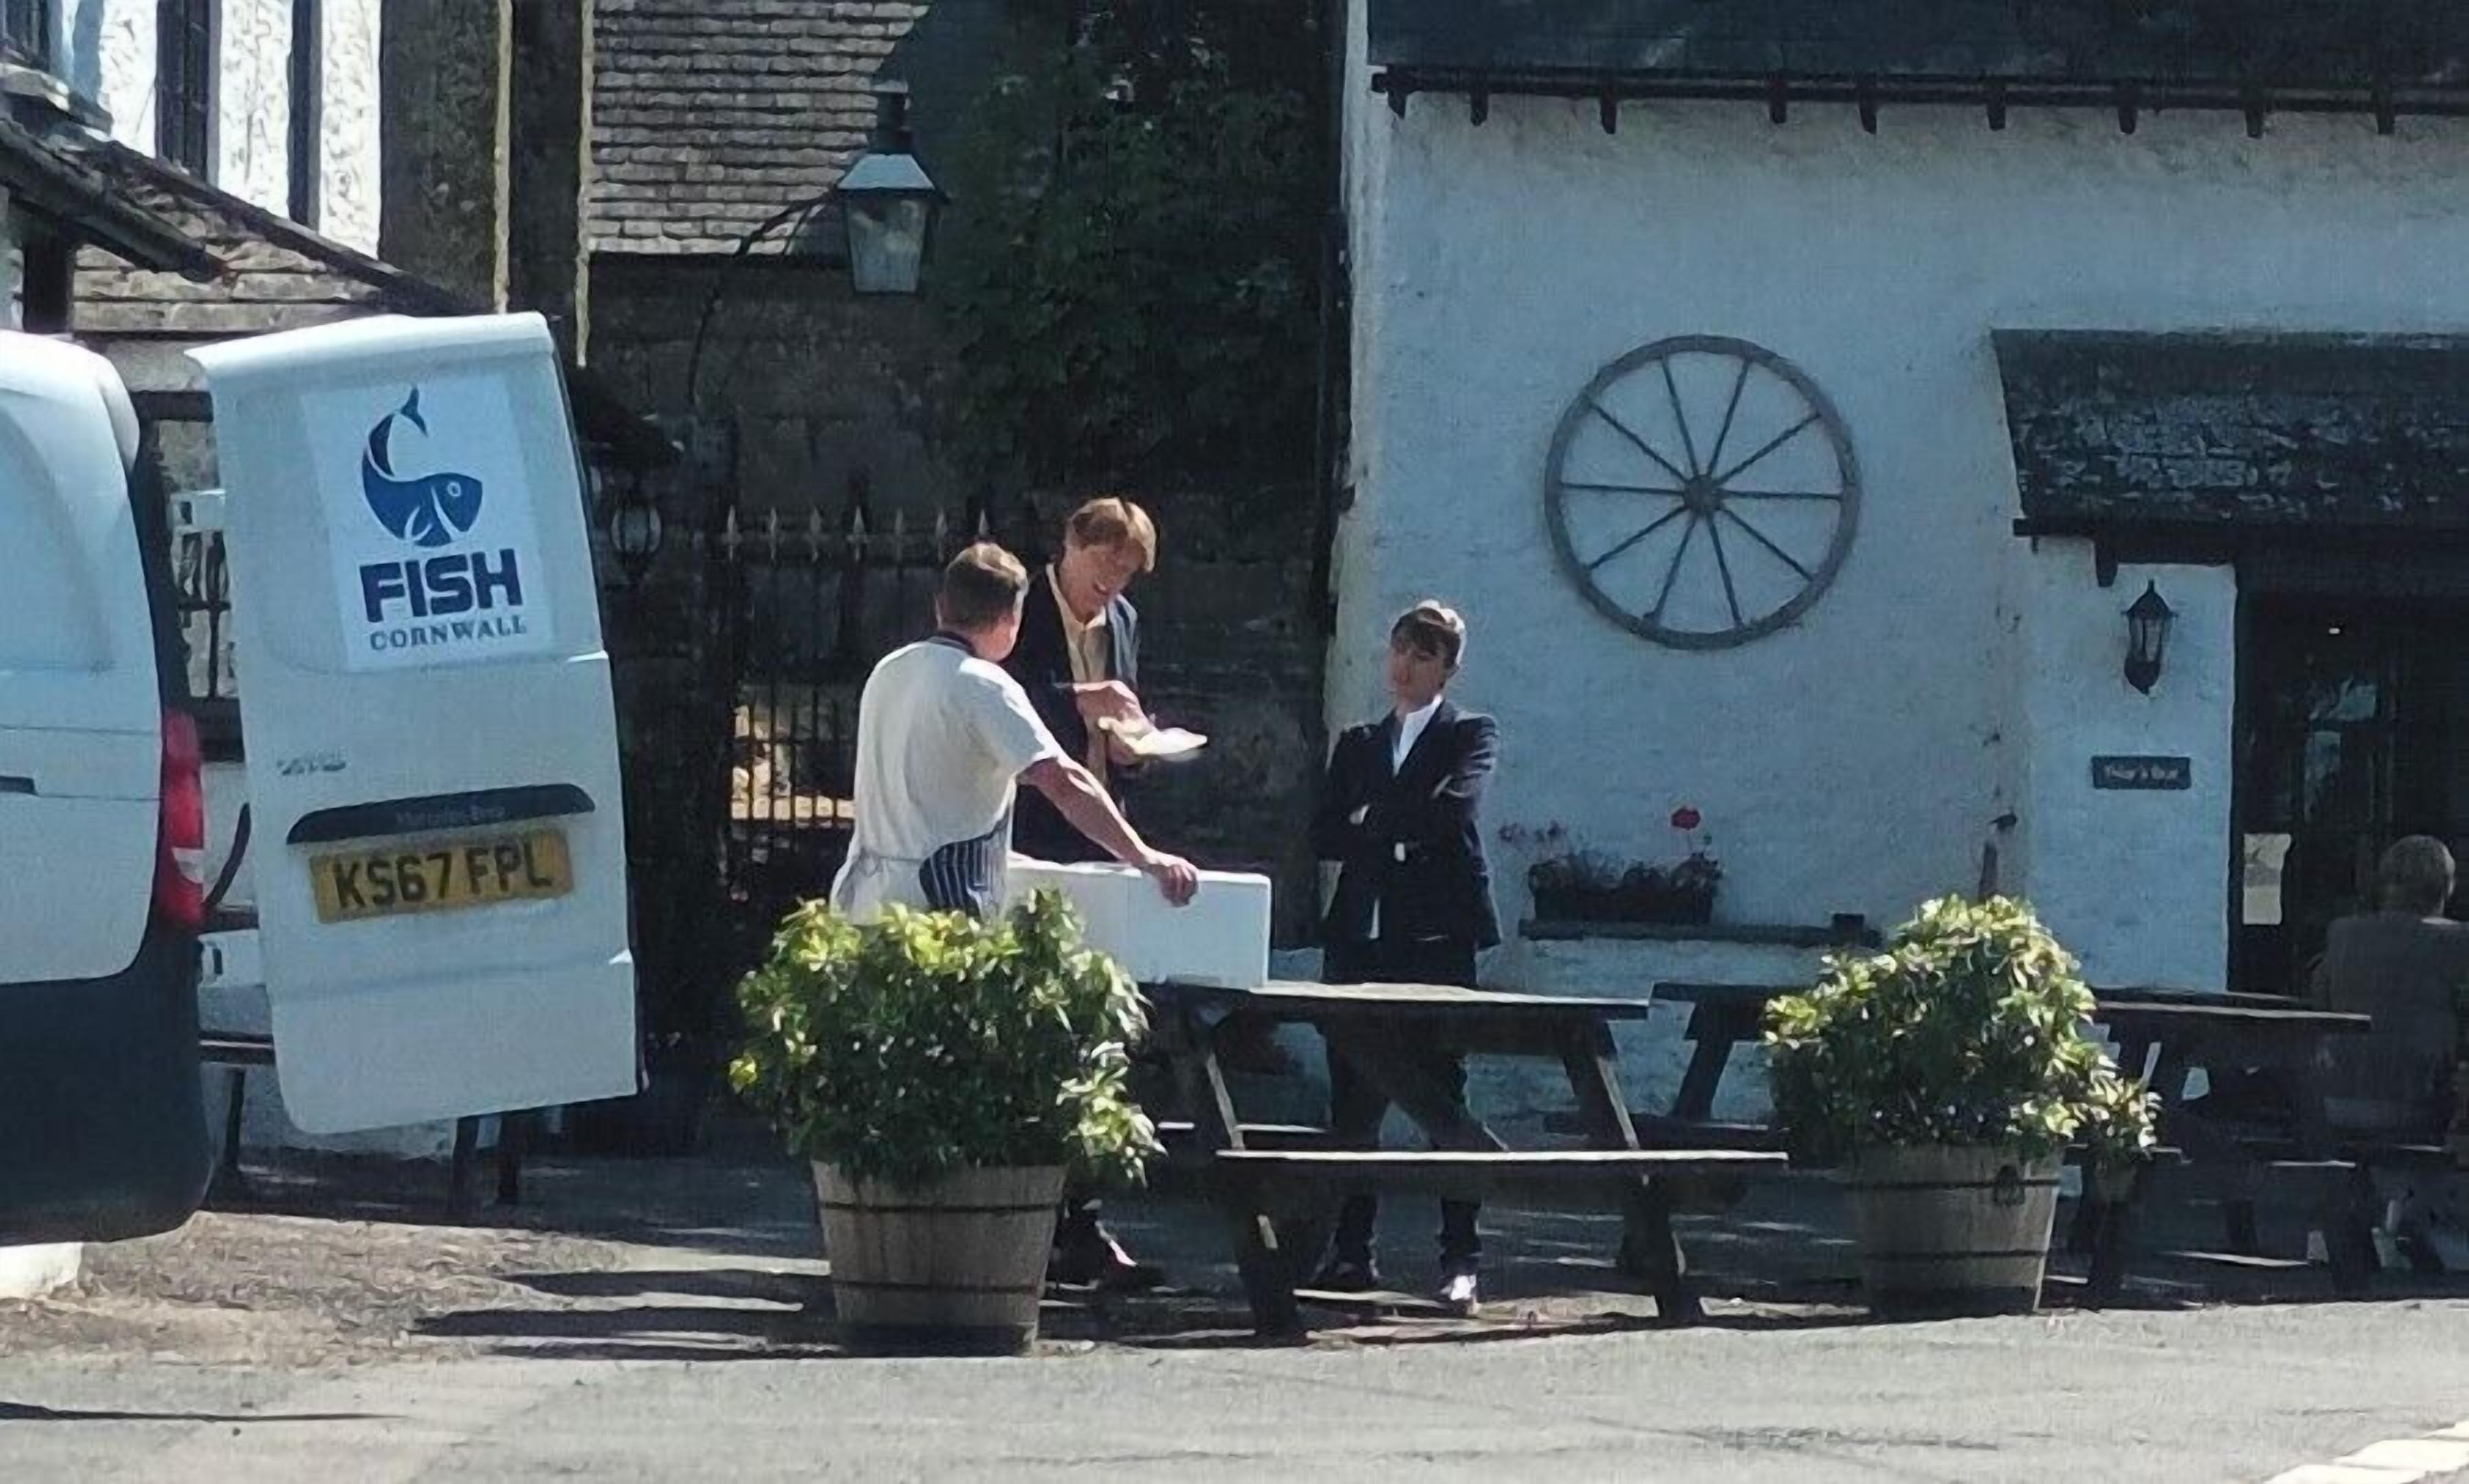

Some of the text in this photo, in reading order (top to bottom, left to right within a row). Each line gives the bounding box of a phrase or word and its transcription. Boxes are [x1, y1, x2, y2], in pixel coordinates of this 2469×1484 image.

[359, 549, 523, 623] FISH
[370, 615, 527, 651] CORNWALL
[333, 835, 553, 911] KS67 FPL
